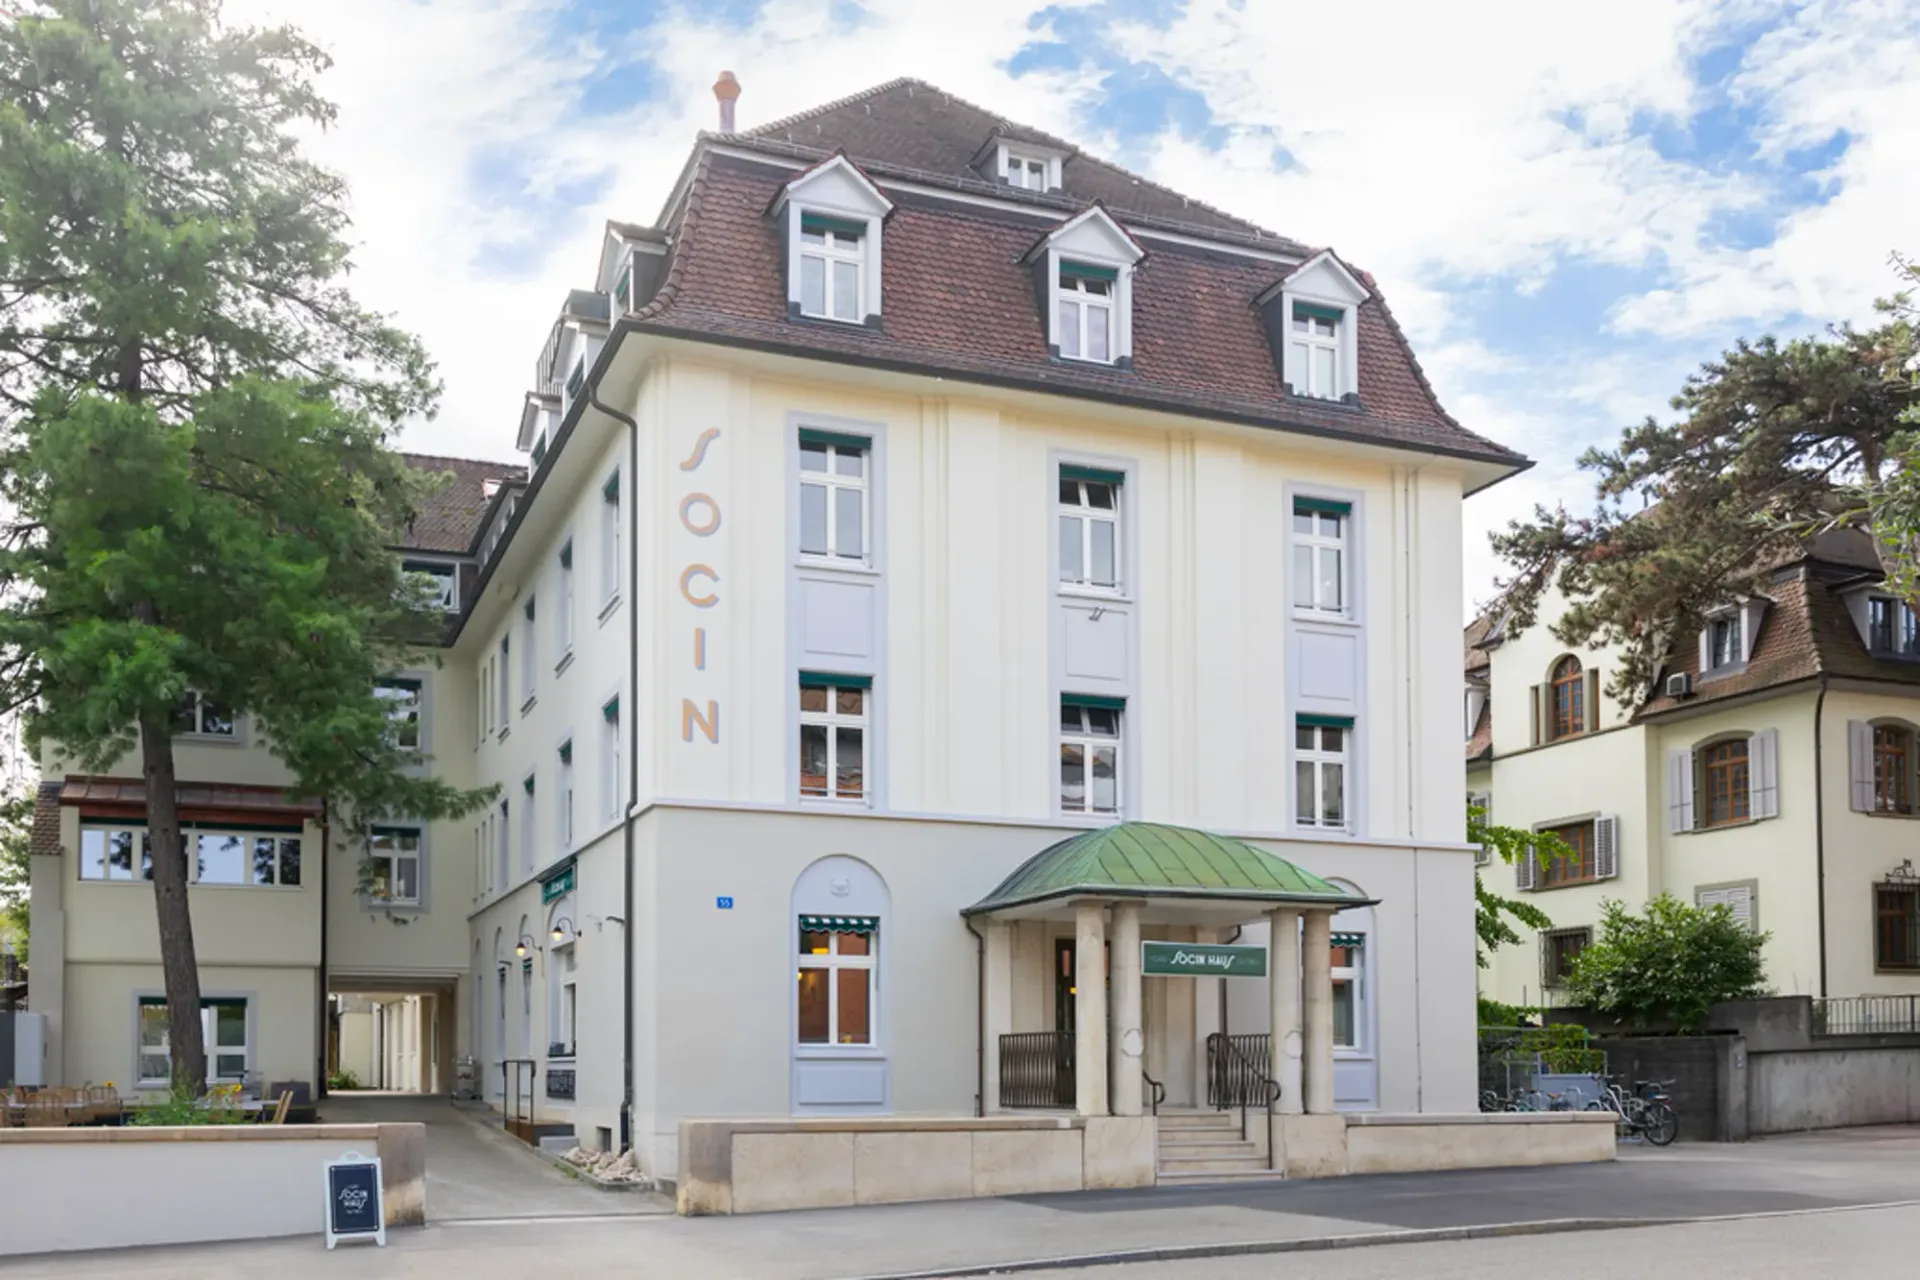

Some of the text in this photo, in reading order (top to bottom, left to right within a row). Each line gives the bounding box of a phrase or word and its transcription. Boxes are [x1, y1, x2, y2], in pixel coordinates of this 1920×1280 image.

[679, 427, 721, 744] SOCIN
[1170, 951, 1204, 965] SOCIN
[1207, 955, 1236, 969] HAUS
